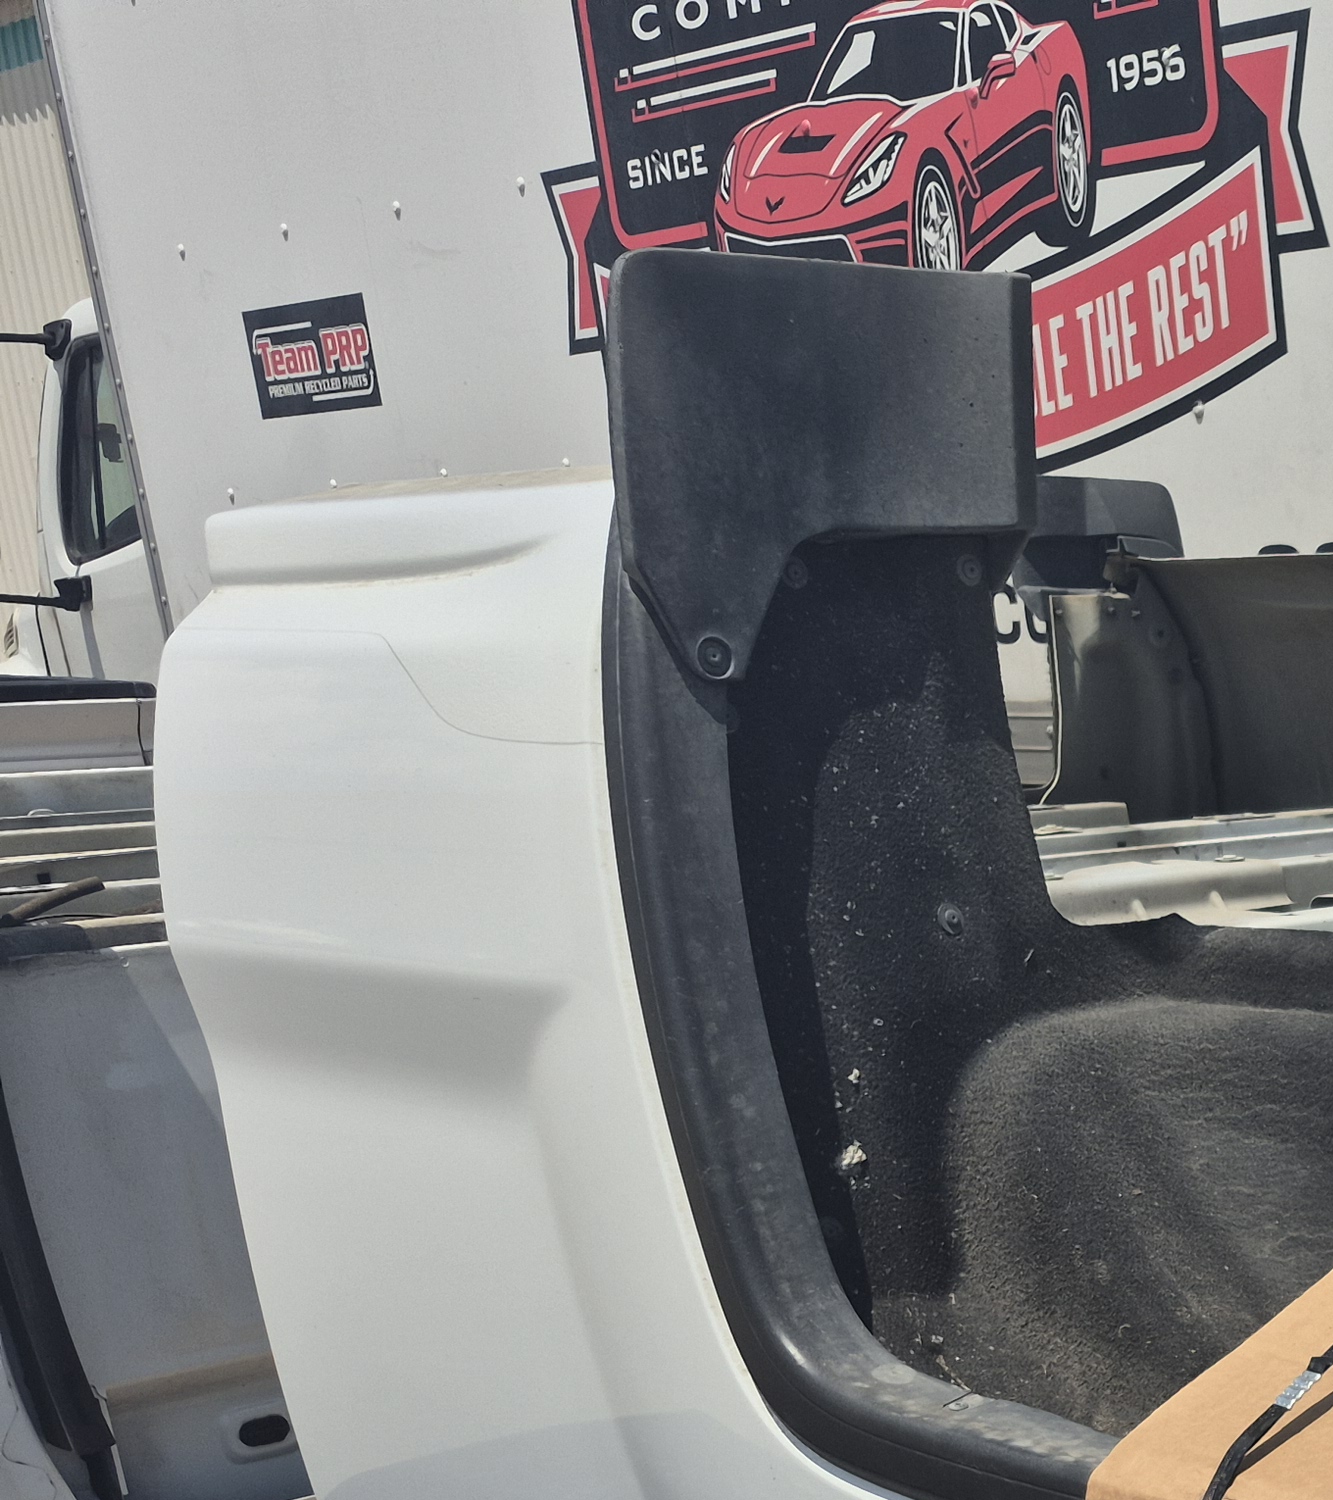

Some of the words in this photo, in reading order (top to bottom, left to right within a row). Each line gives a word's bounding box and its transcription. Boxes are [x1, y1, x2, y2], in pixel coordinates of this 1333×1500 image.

[1106, 43, 1186, 93] 1956
[627, 144, 708, 189] SINCE
[254, 336, 321, 382] Team
[319, 322, 370, 374] PRP
[1033, 313, 1074, 418] LE
[1075, 280, 1143, 399] THE
[268, 381, 304, 399] PREMIUM
[304, 377, 342, 395] RECYCLED
[342, 373, 368, 391] PARTS
